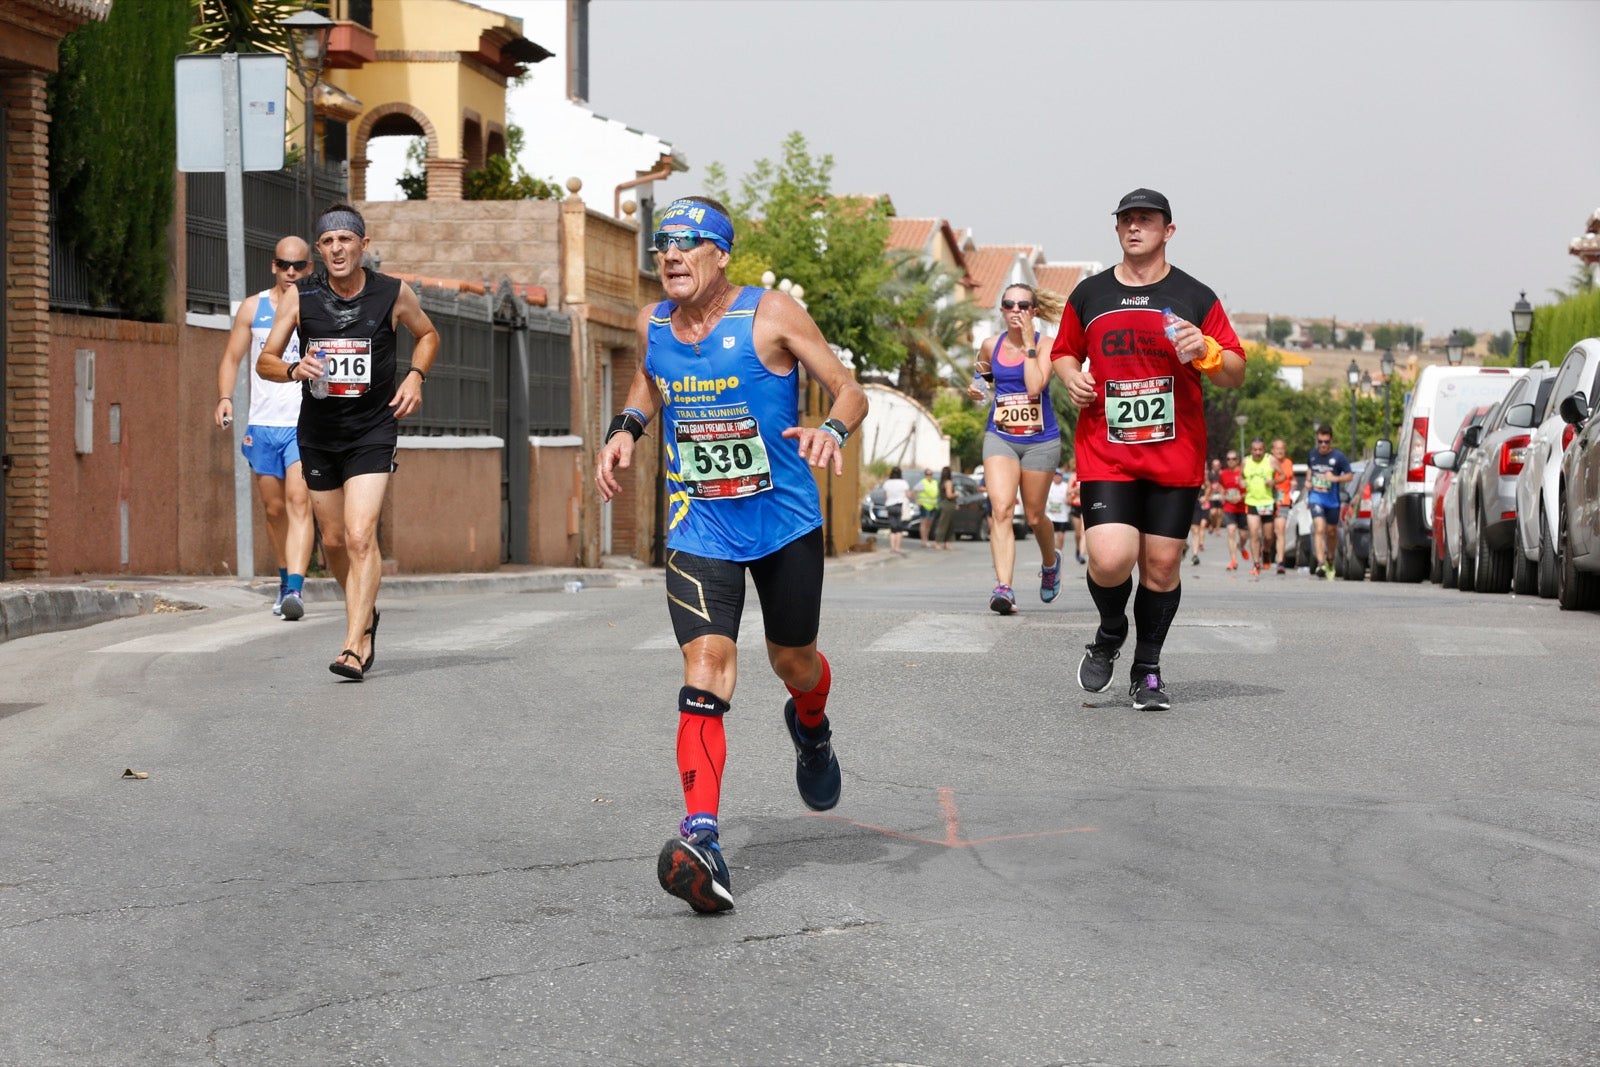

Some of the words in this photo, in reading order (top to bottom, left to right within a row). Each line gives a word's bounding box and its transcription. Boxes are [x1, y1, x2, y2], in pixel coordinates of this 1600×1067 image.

[1120, 296, 1149, 306] Altium
[328, 357, 366, 377] 016
[672, 376, 740, 395] olimpo
[674, 394, 717, 405] deportes
[676, 409, 700, 419] TRAIL
[701, 409, 708, 418] &
[708, 405, 750, 418] RUNNING
[1002, 407, 1039, 422] 2069
[1117, 398, 1165, 423] 202
[690, 423, 705, 434] GRAN
[705, 422, 727, 433] PREMIO
[726, 421, 735, 432] DE
[694, 443, 753, 474] 530
